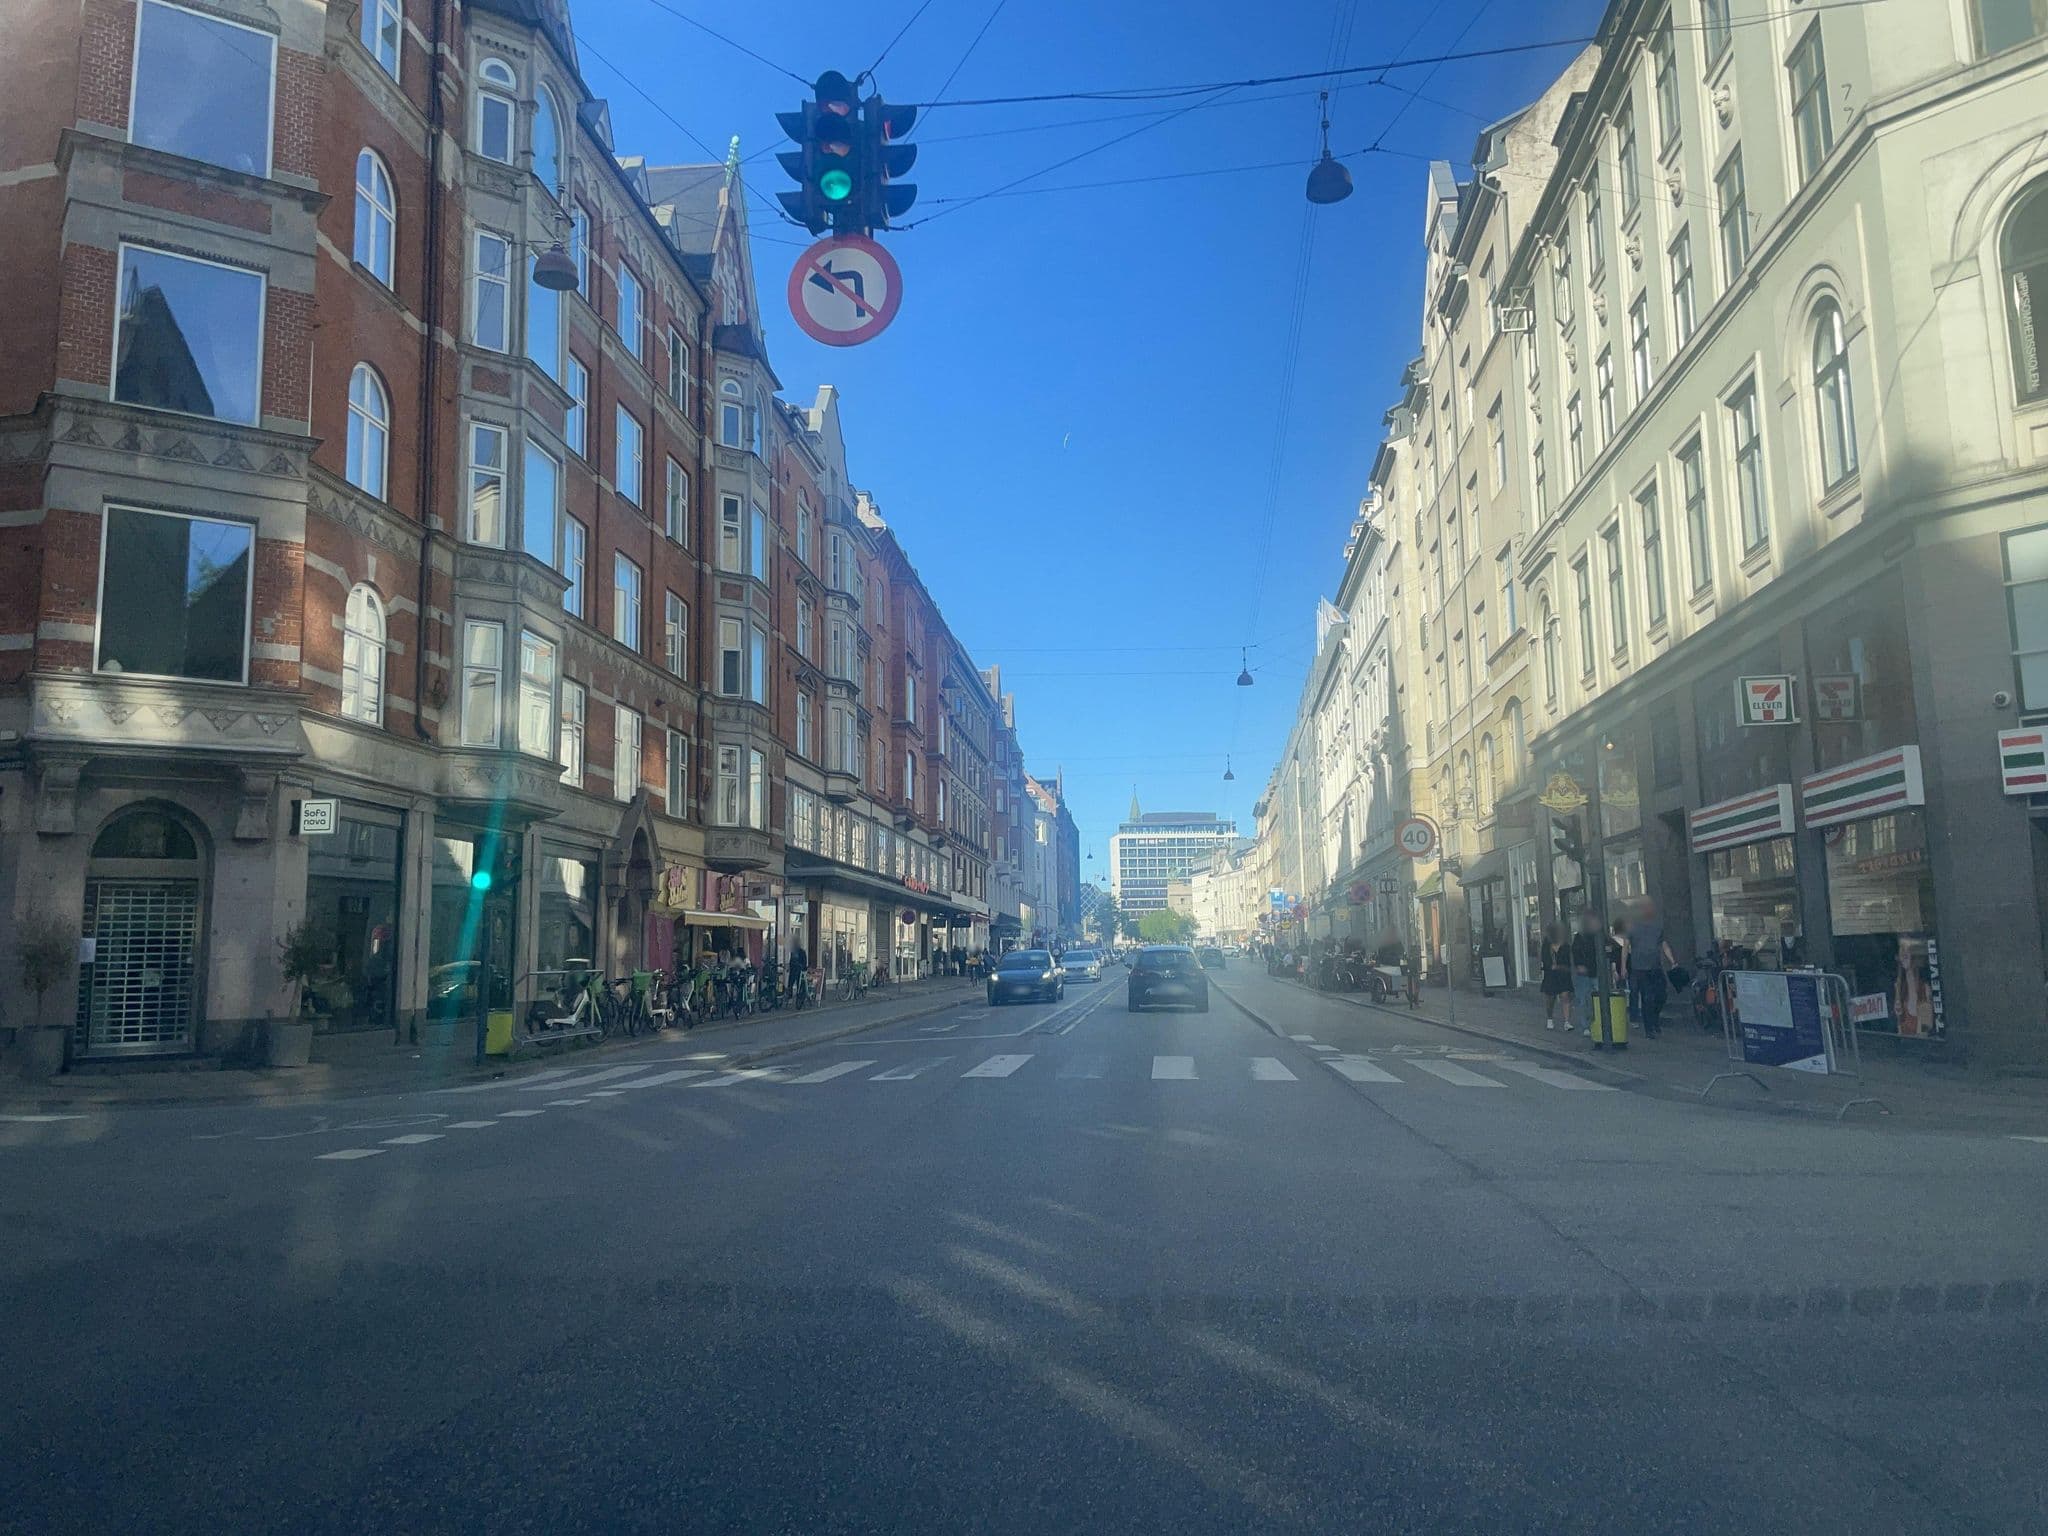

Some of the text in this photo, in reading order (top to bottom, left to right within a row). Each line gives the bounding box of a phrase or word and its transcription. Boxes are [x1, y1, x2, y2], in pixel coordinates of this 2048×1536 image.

[1751, 684, 1781, 720] 7
[304, 809, 327, 817] Sofa
[1403, 830, 1428, 845] 40
